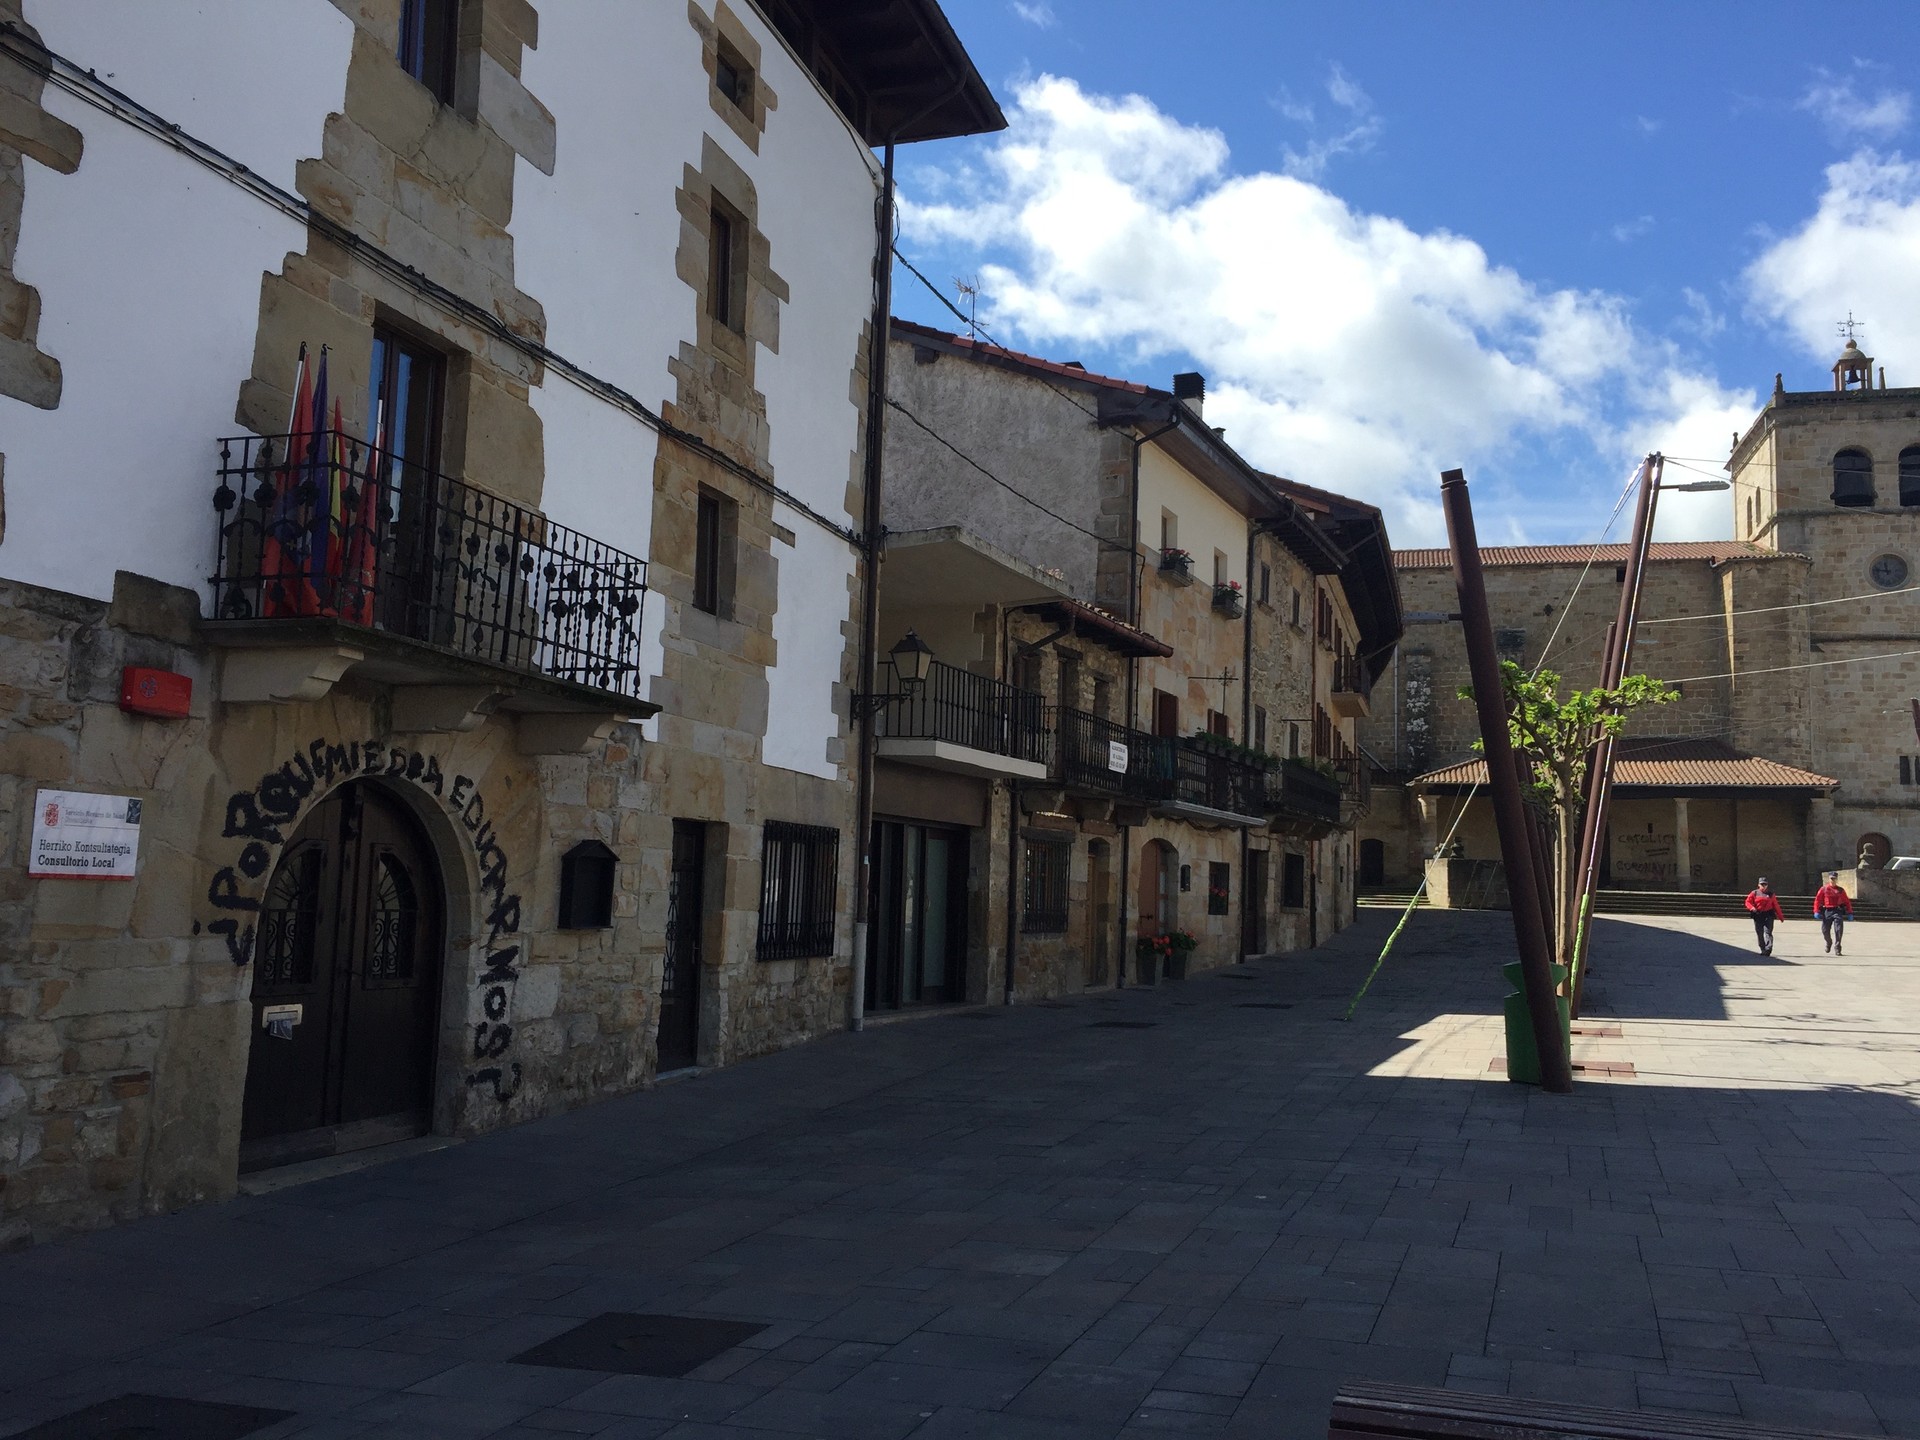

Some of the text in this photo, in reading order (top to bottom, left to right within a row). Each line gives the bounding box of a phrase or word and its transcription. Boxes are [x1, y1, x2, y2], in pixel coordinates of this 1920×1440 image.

[39, 839, 131, 857] Herriko Kontsultategia
[1617, 832, 1709, 848] CATOLICIMO
[38, 854, 115, 868] Consultorio Local
[1615, 860, 1704, 878] CORONAVIS
